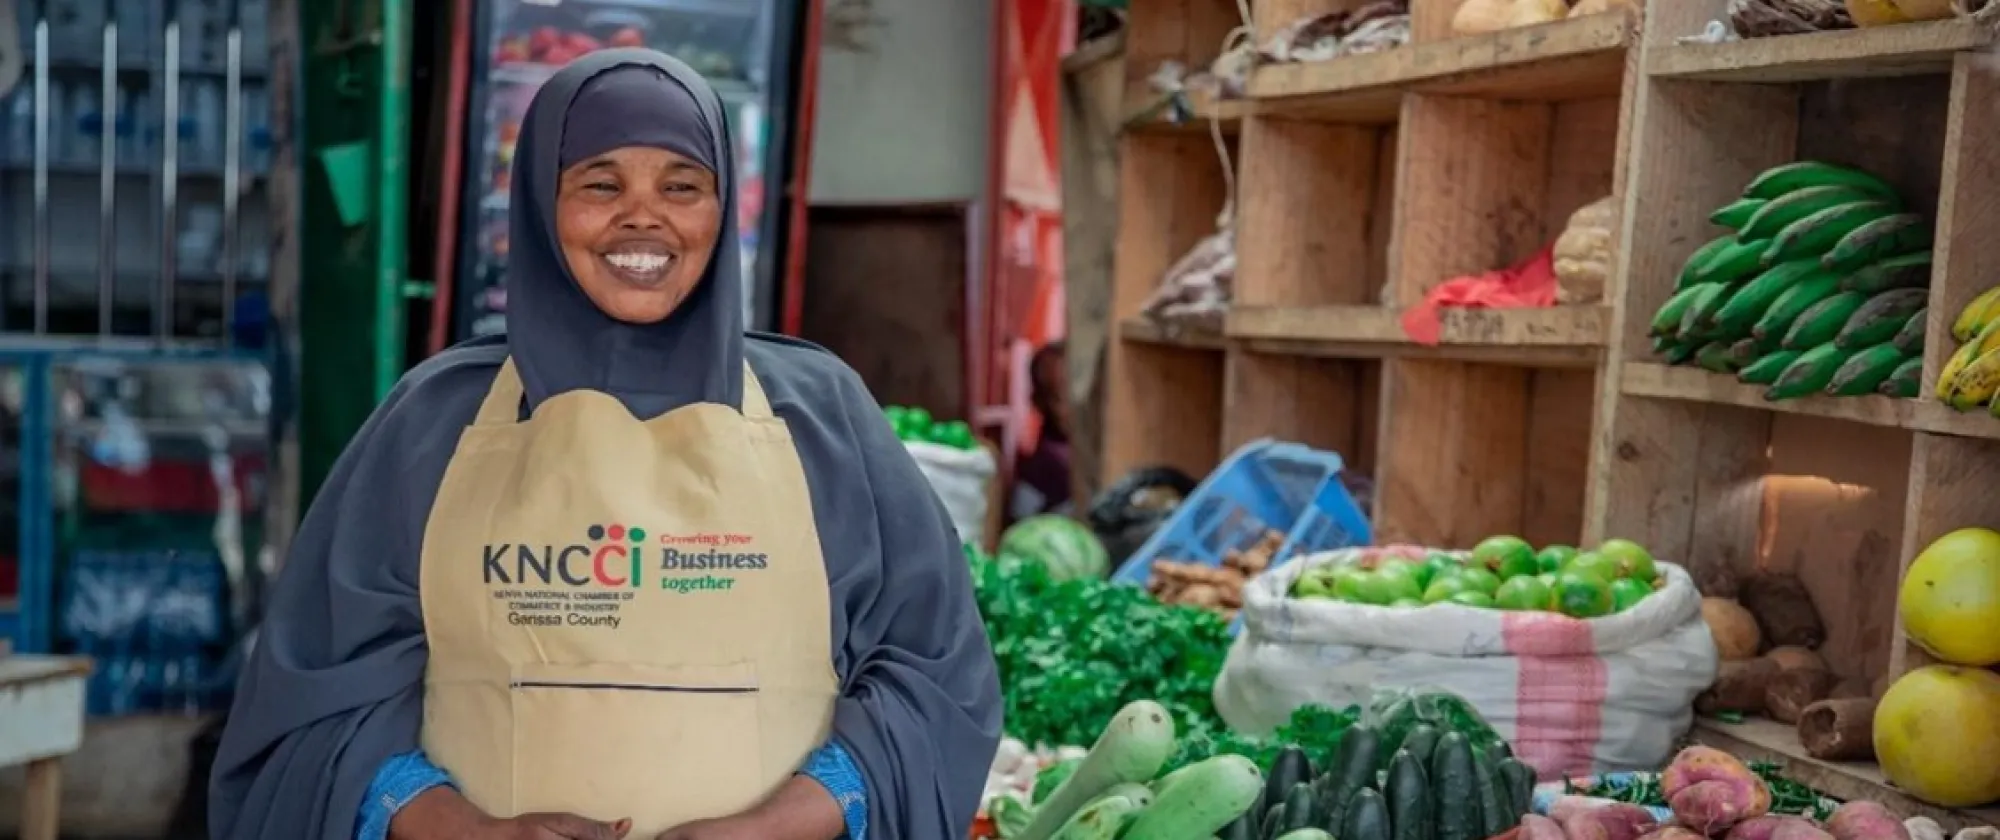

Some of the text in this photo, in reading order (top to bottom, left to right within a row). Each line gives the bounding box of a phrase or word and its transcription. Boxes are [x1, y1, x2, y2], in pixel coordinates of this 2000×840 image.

[661, 548, 768, 570] Business
[661, 574, 735, 594] together
[524, 590, 570, 600] NATIONAL
[574, 591, 620, 600] CHAMBER
[508, 611, 621, 629] Garissa County
